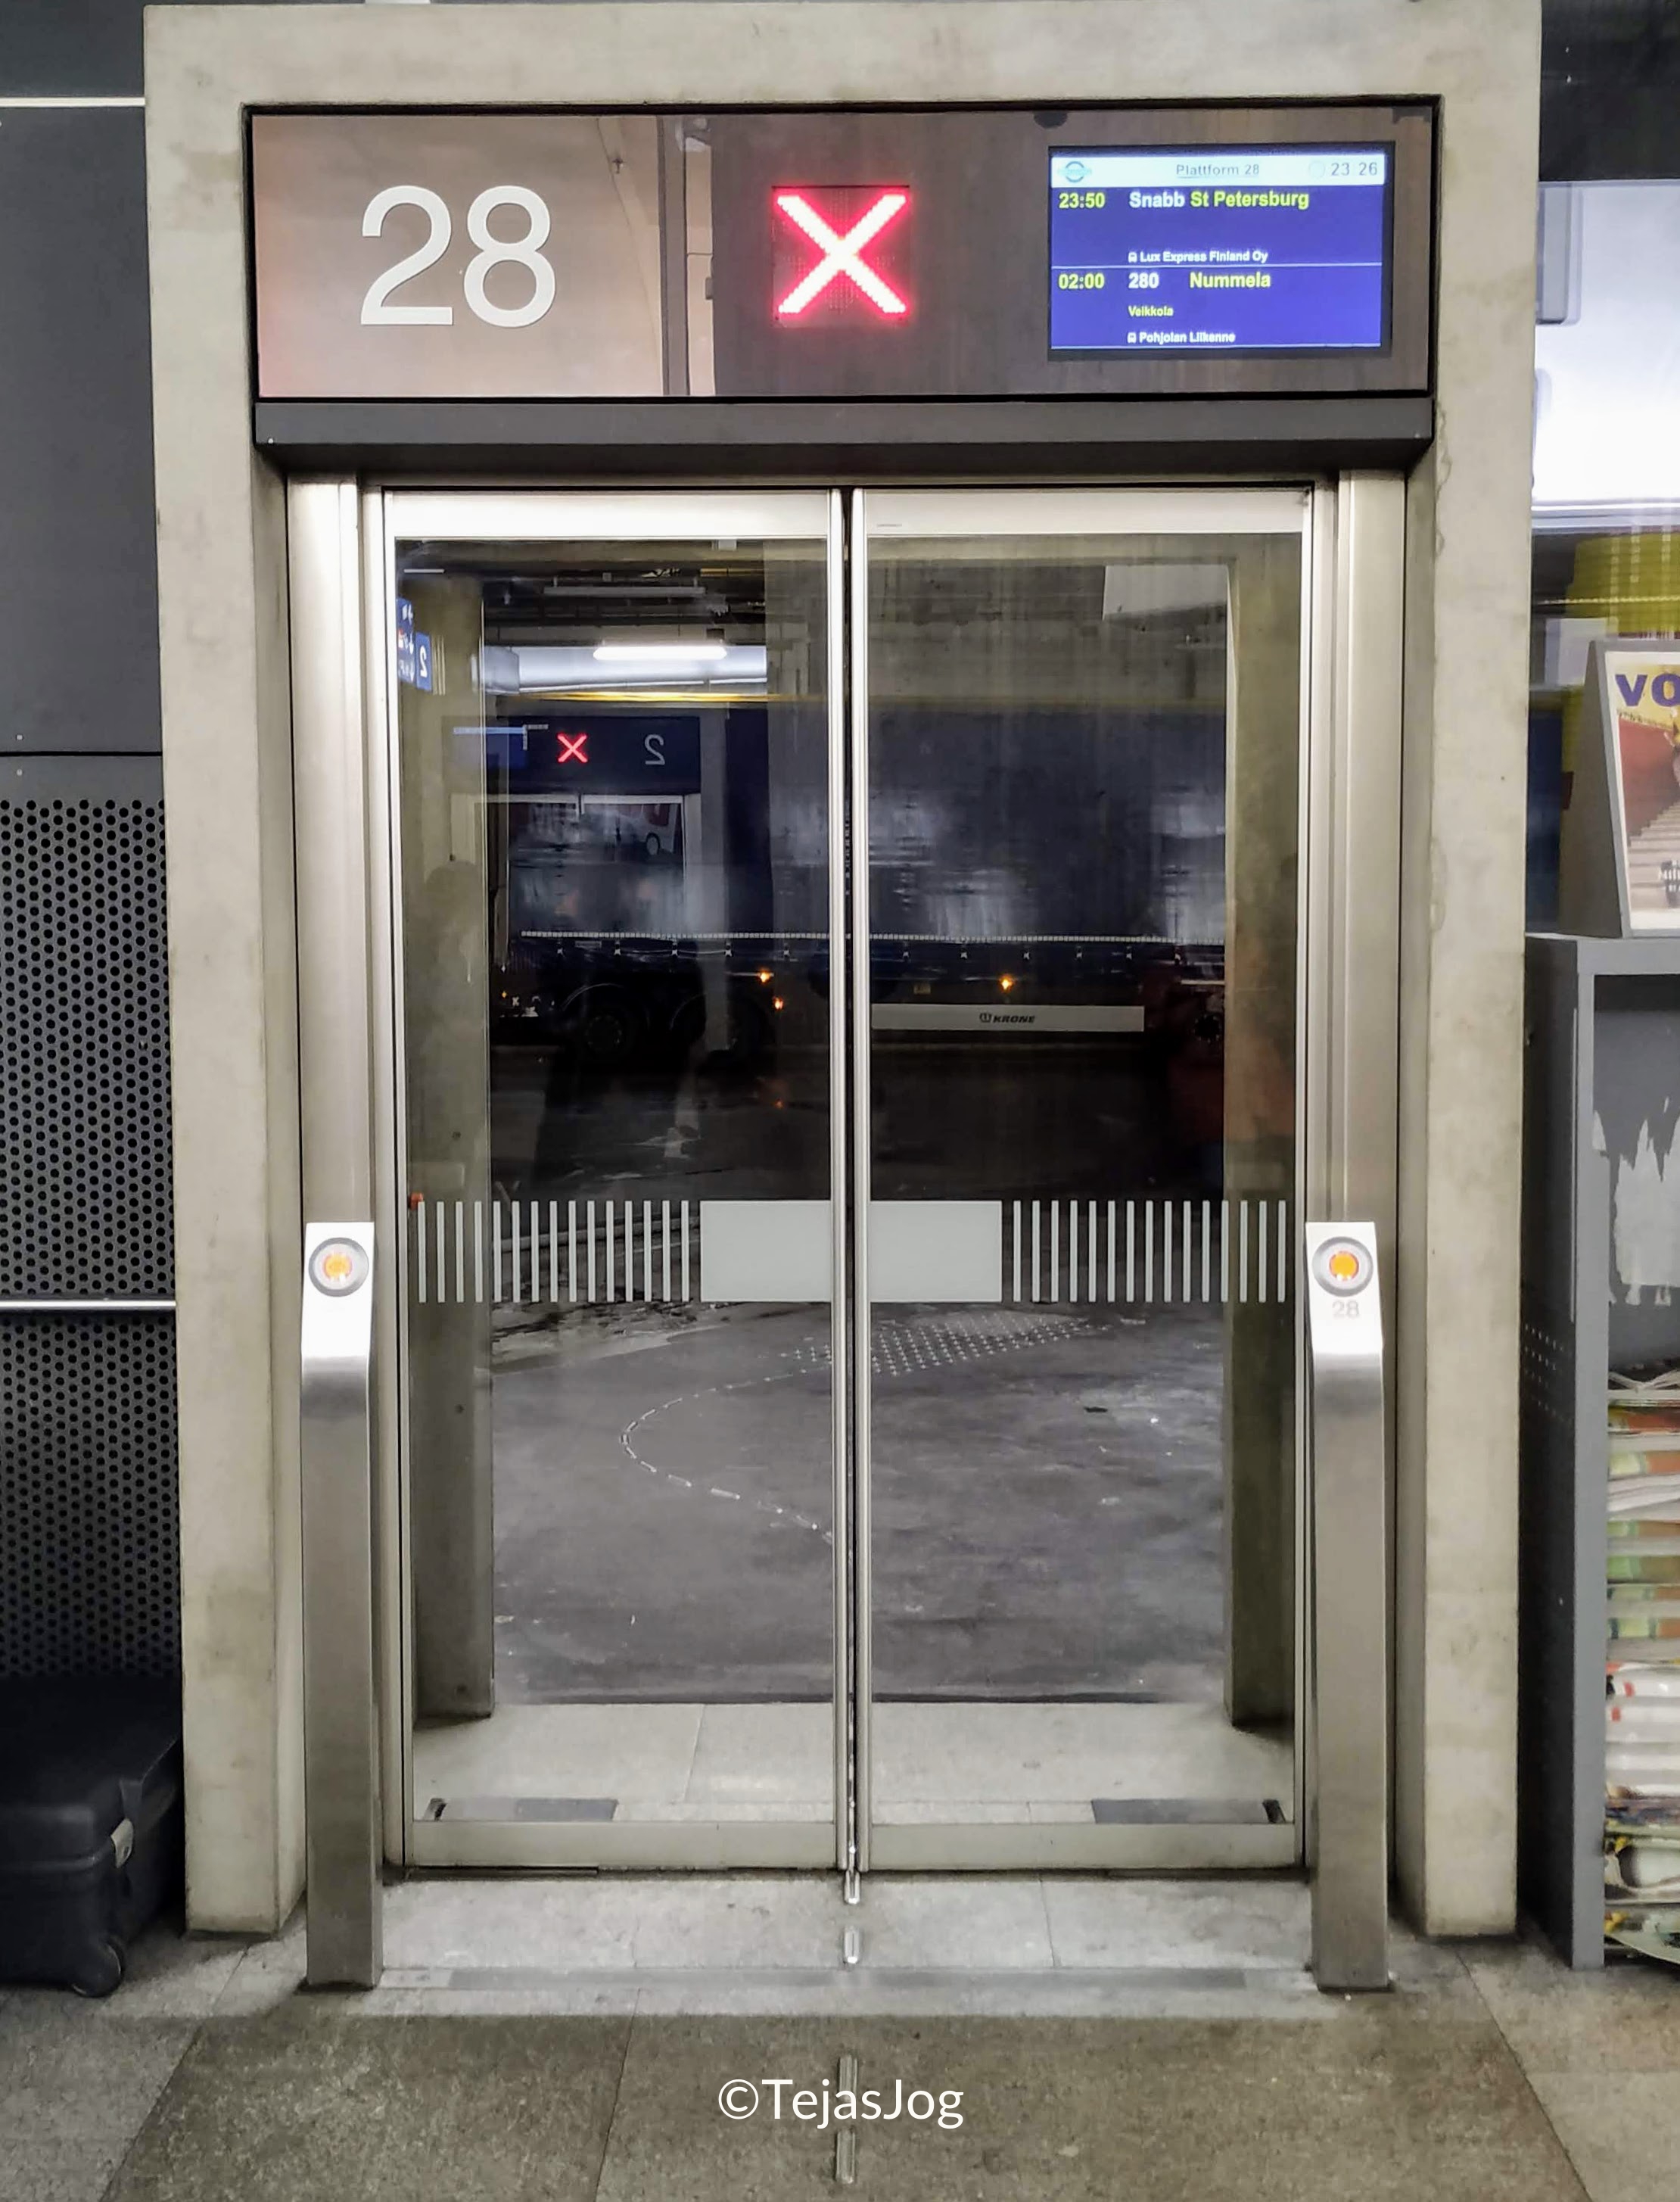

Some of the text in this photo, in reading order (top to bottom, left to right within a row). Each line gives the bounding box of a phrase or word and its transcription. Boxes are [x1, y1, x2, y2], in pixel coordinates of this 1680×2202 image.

[1175, 163, 1260, 176] Plattform 28
[1059, 190, 1310, 210] 23:50 Snabb St Petersburg
[360, 185, 556, 328] 28
[1140, 251, 1268, 263] Lux Express Finland Oy
[1059, 272, 1271, 289] 02:00 280 Nummela
[1139, 332, 1187, 345] Pohjolan
[993, 1015, 1035, 1023] KRONE
[1332, 1300, 1359, 1319] 28
